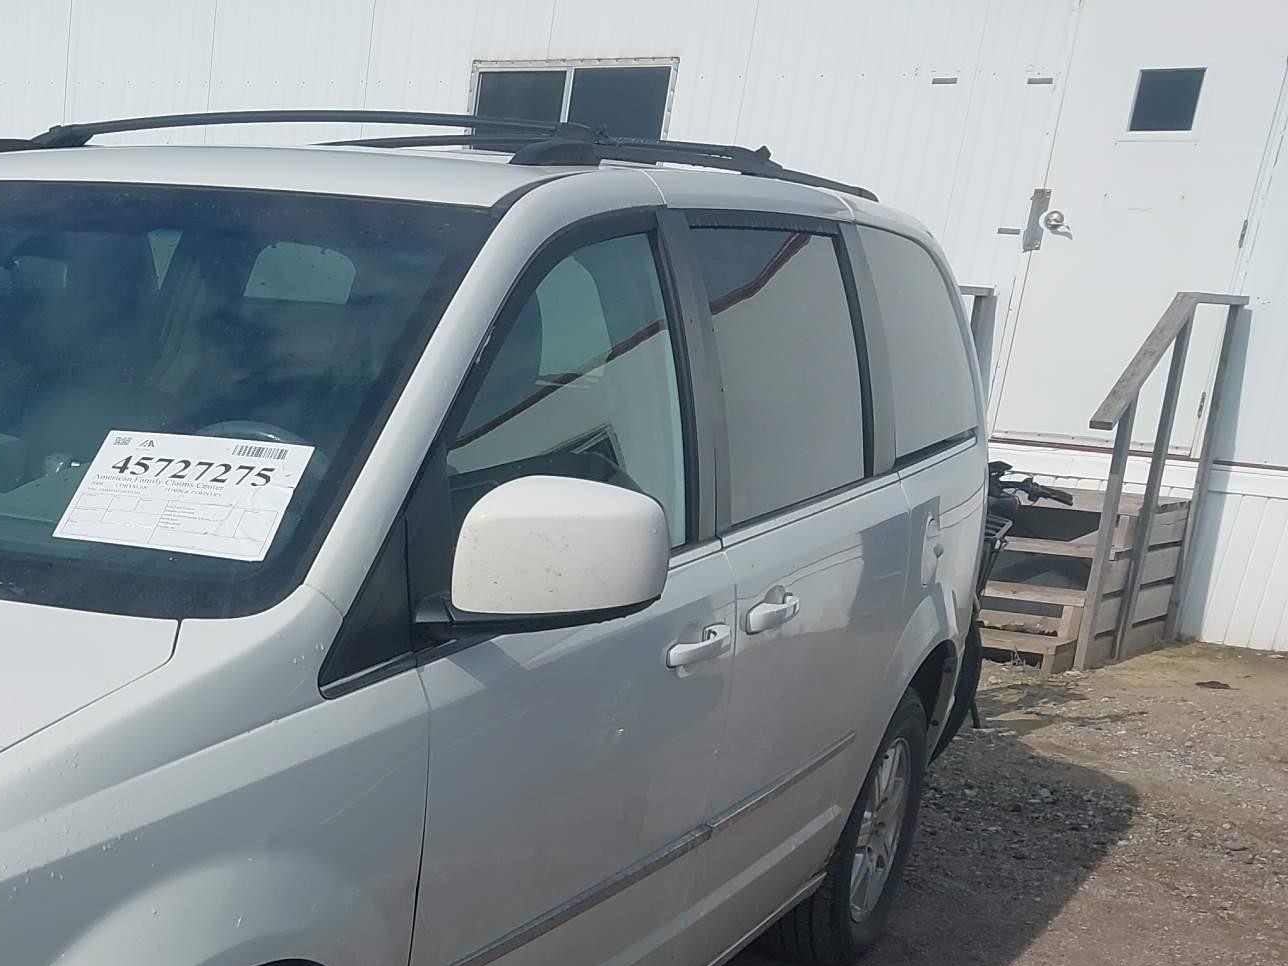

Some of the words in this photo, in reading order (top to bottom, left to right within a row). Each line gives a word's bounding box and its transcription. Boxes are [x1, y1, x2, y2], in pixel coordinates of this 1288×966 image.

[94, 473, 132, 483] American
[134, 477, 162, 486] Family
[164, 480, 194, 489] Claims
[196, 482, 225, 491] Center
[111, 455, 276, 487] 45727275
